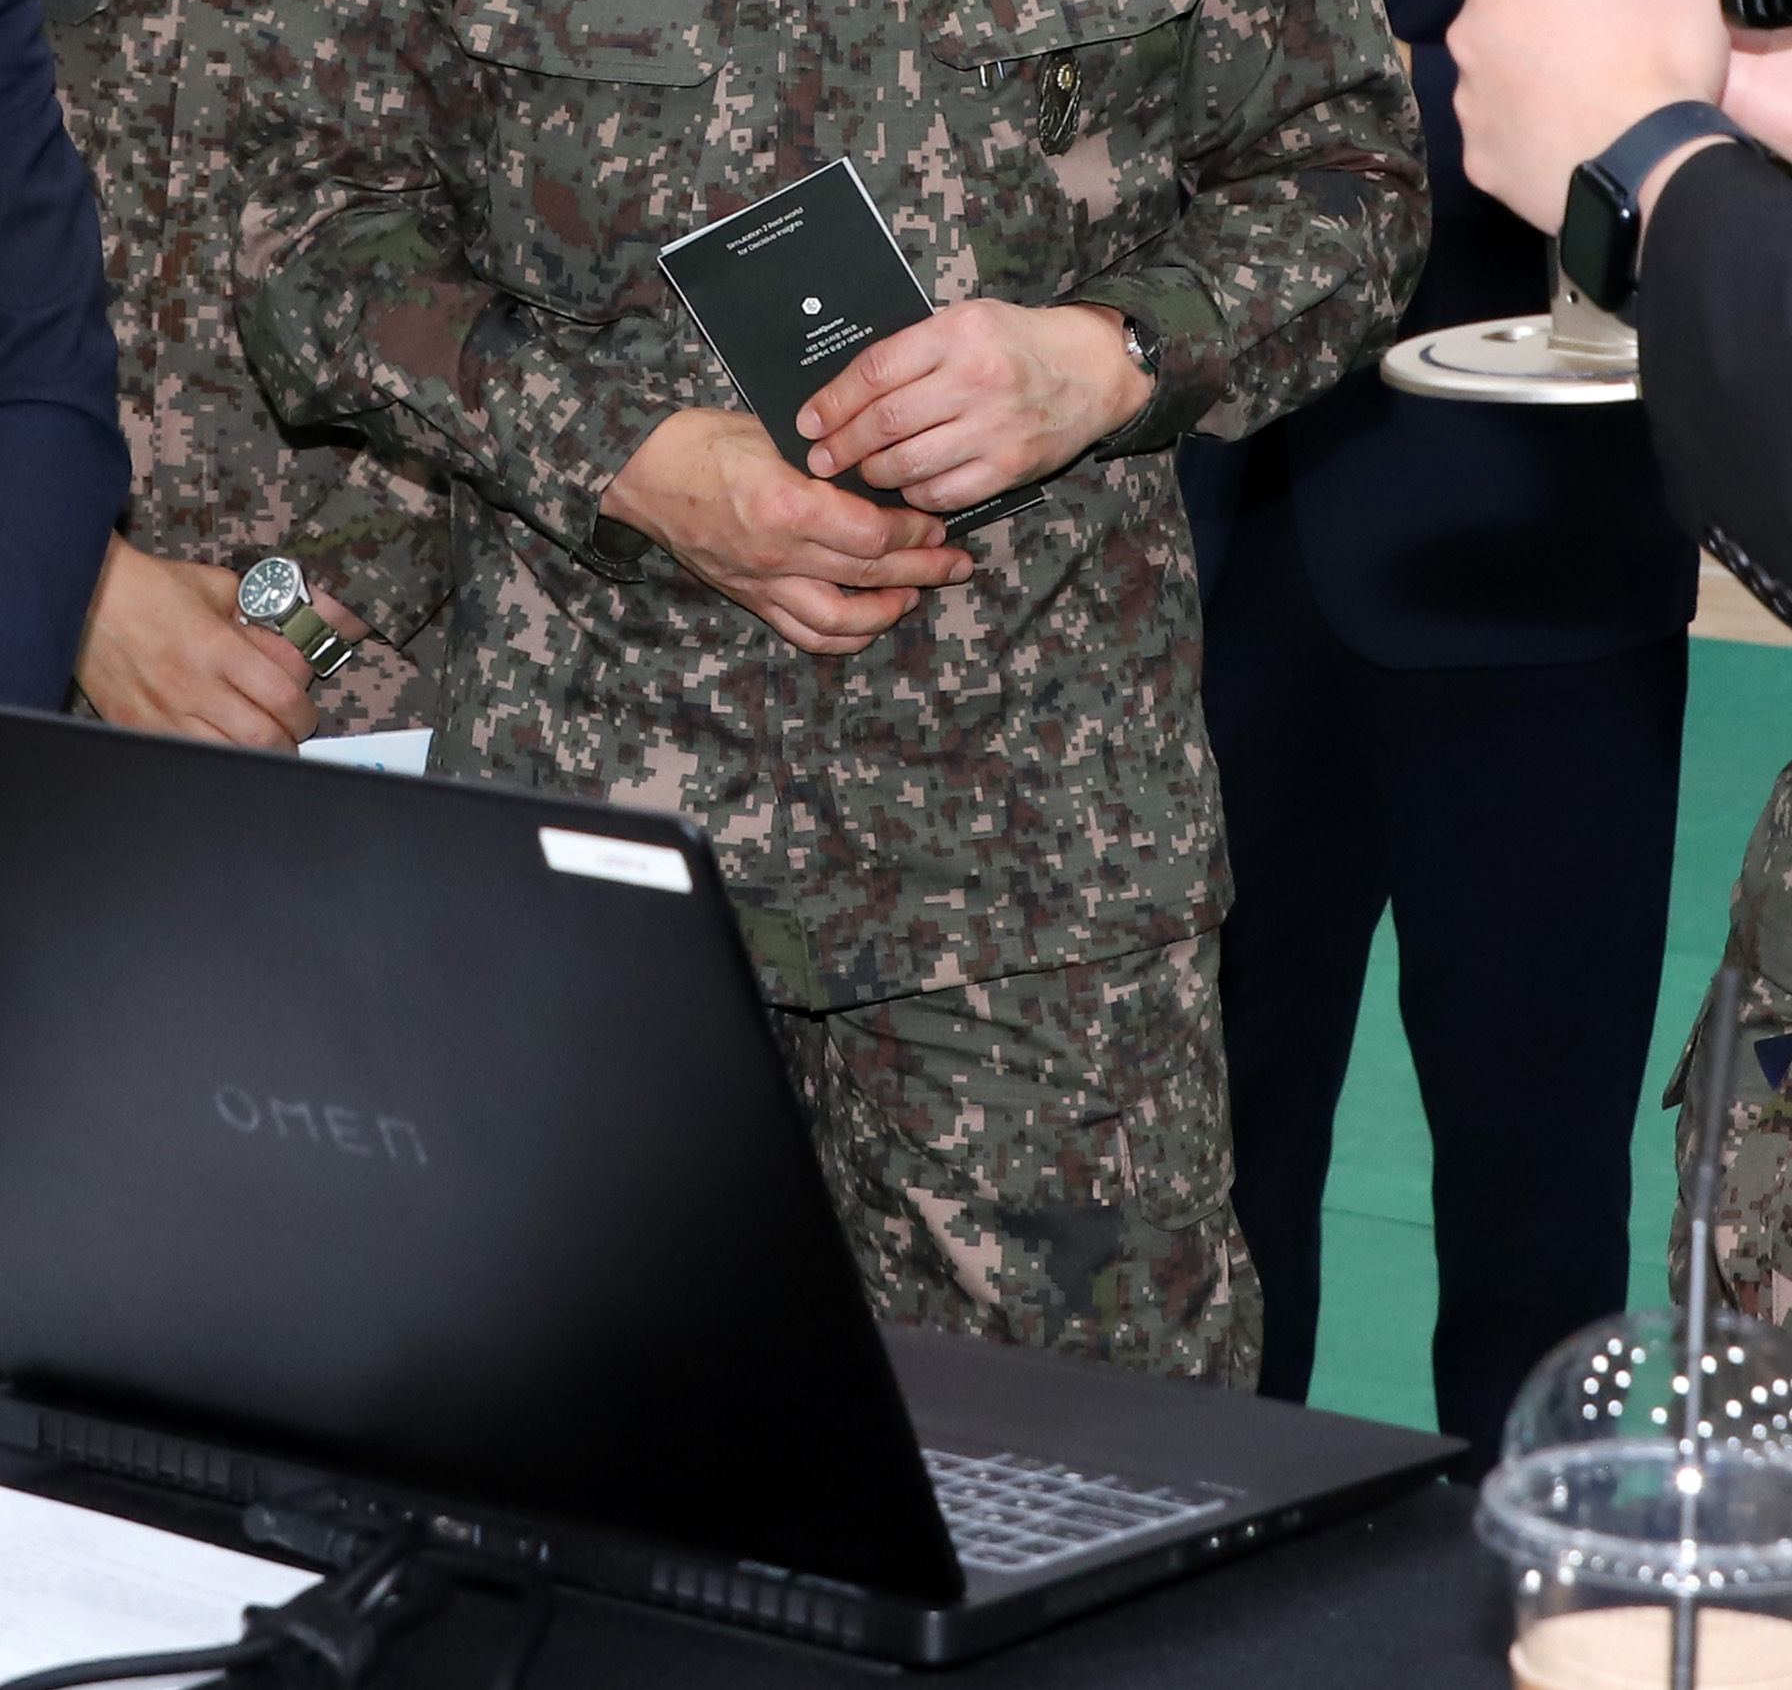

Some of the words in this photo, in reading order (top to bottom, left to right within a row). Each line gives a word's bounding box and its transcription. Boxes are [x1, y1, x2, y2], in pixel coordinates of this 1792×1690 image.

[726, 228, 763, 250] Simulation
[737, 248, 748, 256] for
[748, 233, 777, 251] Decisive
[212, 1082, 428, 1168] OMEN
